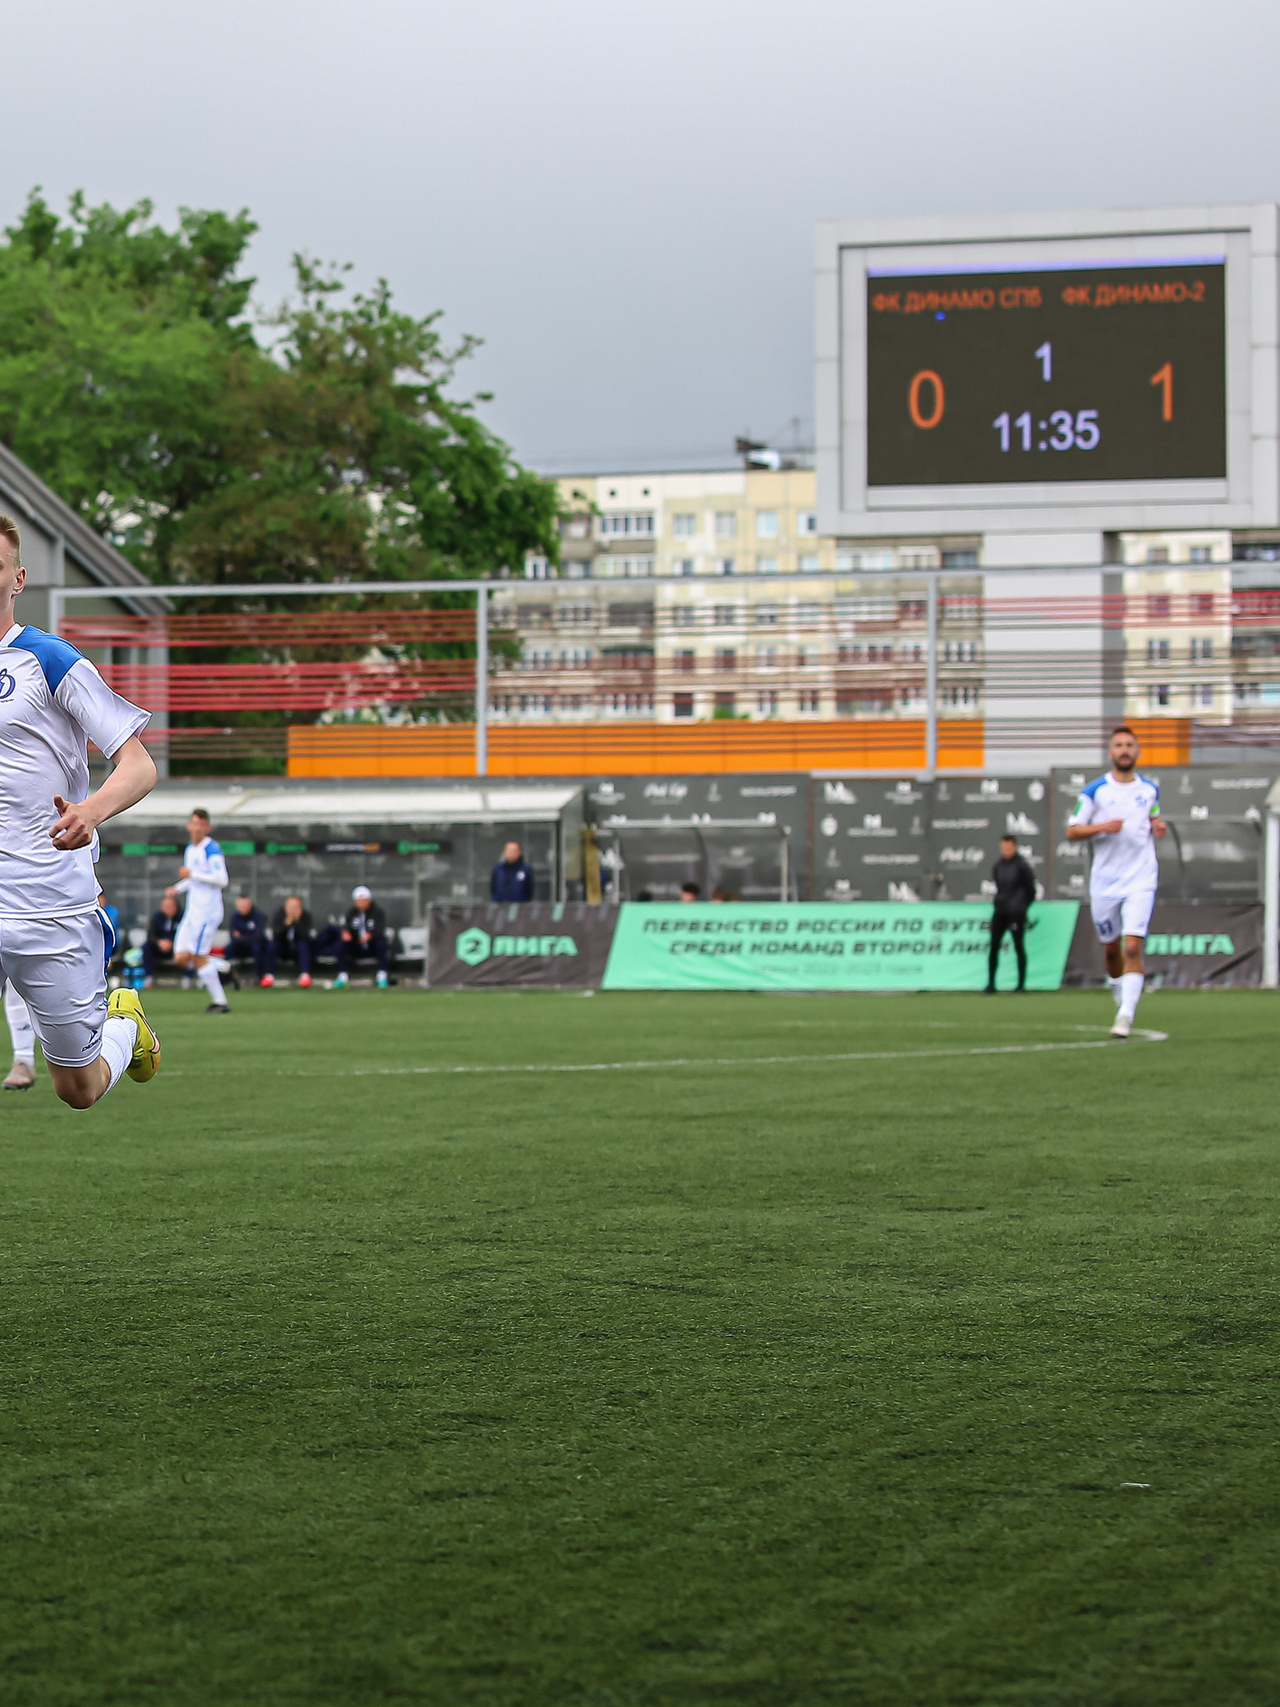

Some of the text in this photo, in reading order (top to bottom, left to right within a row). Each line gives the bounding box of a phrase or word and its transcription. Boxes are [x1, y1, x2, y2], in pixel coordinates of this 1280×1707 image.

[872, 292, 901, 312] ФК
[904, 289, 995, 312] ДИНАМО
[1062, 280, 1205, 307] ФК ДИНАМО-2
[1034, 340, 1053, 383] 1
[908, 368, 946, 430] 0
[1150, 360, 1173, 422] 1
[992, 408, 1101, 452] 11:35
[642, 918, 1039, 935] ПЕРВЕНСТВО РОССИИ ПО ФУТБУ
[491, 935, 579, 957] ЛИГА
[669, 940, 743, 955] СРЕДИ
[749, 940, 846, 956] КОМАНД
[852, 936, 942, 955] ВТОРОЙ
[1145, 933, 1236, 956] ЛИГА
